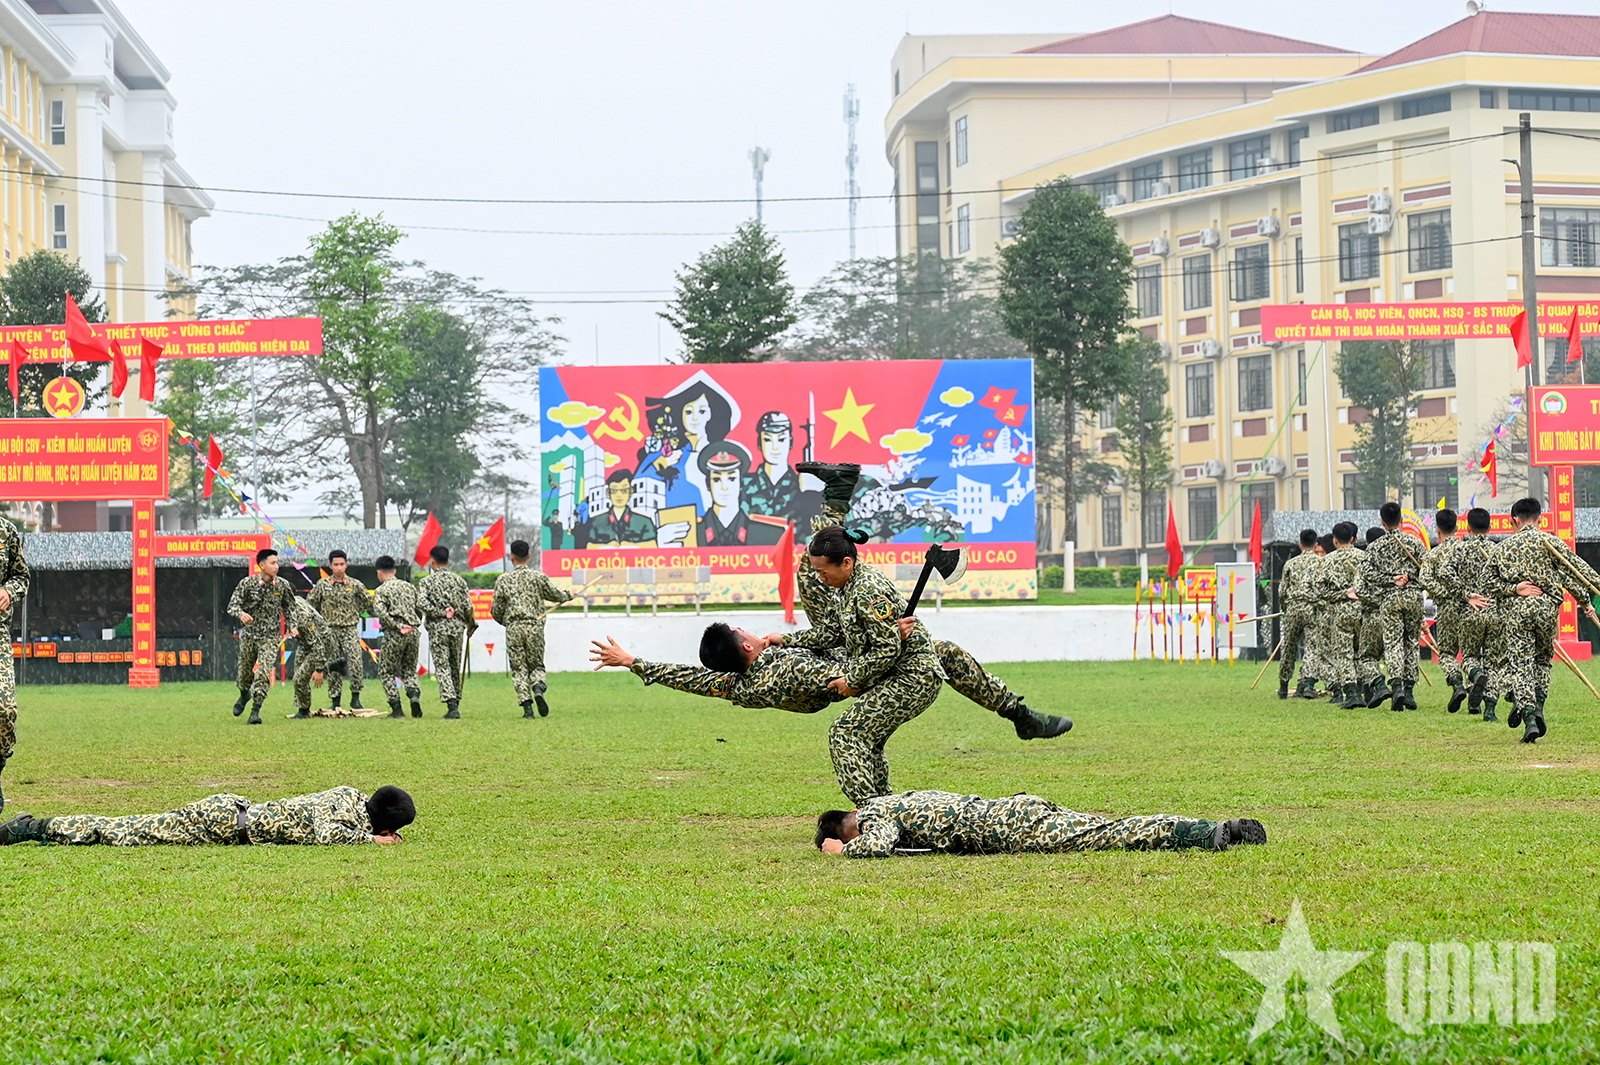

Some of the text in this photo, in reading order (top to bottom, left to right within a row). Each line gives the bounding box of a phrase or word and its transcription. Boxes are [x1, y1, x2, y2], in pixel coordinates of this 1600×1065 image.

[1311, 307, 1332, 320] CÁN
[1336, 306, 1352, 322] BỘ,
[1355, 308, 1376, 321] HỌC
[1378, 306, 1405, 320] VIÊN,
[1408, 308, 1440, 320] QNCN,
[1443, 307, 1464, 319] HSQ
[1474, 306, 1488, 318] BS
[1490, 304, 1524, 317] TRƯỜN
[1578, 303, 1598, 318] ĐẶC
[105, 325, 136, 340] THIẾT
[140, 326, 169, 340] THỰC
[180, 323, 211, 337] VỮNG
[1275, 324, 1306, 338] QUYẾT
[1309, 324, 1332, 337] TÂM
[1334, 326, 1350, 336] THI
[1353, 326, 1374, 336] ĐUA
[1376, 323, 1404, 336] HOÀN
[1407, 323, 1440, 336] THÀNH
[1444, 321, 1470, 335] XUẤT
[1472, 320, 1493, 334] SẮC
[1538, 323, 1546, 336] Ụ
[1580, 322, 1600, 333] LUY
[187, 343, 215, 354] THEO
[218, 340, 257, 353] HƯỚNG
[260, 338, 287, 354] HIỆN
[290, 340, 310, 354] ĐẠI
[0, 438, 9, 456] ẠI
[11, 435, 24, 456] ĐỘI
[86, 433, 106, 452] HUẤN
[108, 434, 132, 456] LUYỆN
[1540, 432, 1554, 450] KHU
[1580, 427, 1594, 450] BÀY
[8, 462, 21, 482] BÀY
[22, 462, 34, 482] MÔ
[35, 462, 54, 484] HÌNH,
[55, 465, 68, 485] HỌC
[70, 465, 80, 485] CỤ
[81, 459, 100, 481] HUẤN
[101, 461, 122, 484] LUYỆN
[124, 462, 140, 481] NĂM
[190, 539, 204, 551] KẾT
[206, 538, 229, 552] QUYẾT
[710, 554, 750, 570] PHỤC
[986, 550, 1017, 564] CAO
[158, 654, 164, 663] 2
[168, 655, 174, 663] 3
